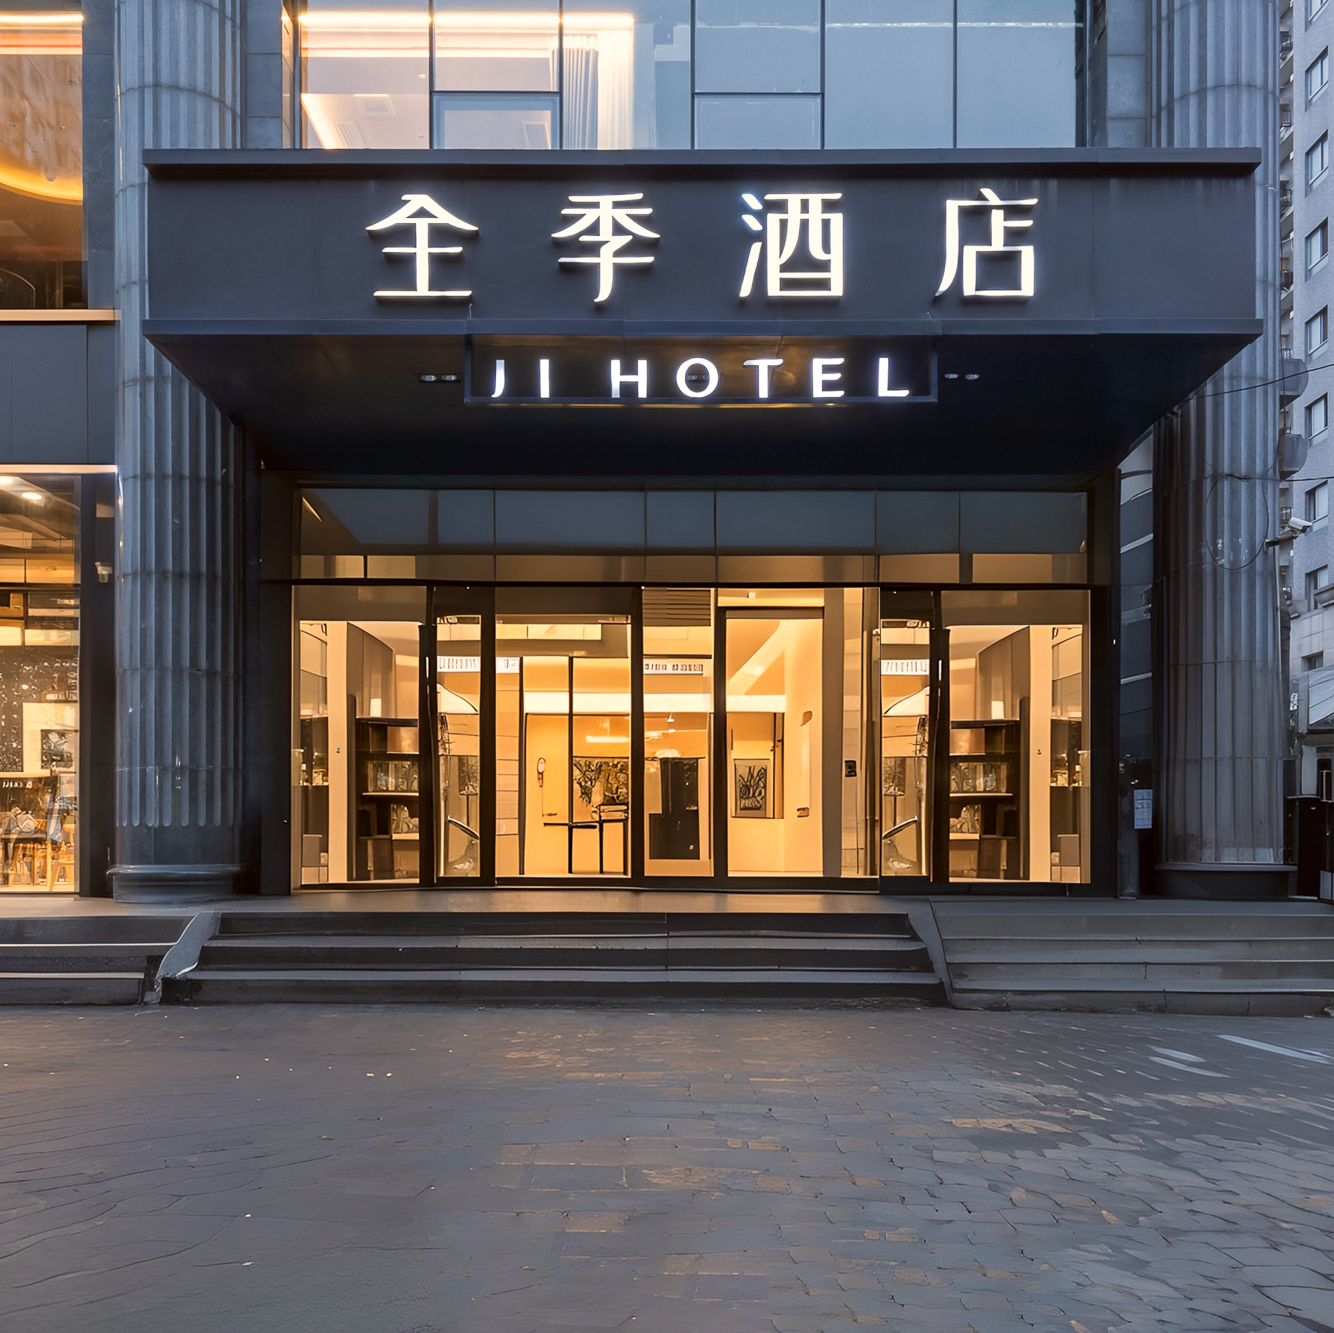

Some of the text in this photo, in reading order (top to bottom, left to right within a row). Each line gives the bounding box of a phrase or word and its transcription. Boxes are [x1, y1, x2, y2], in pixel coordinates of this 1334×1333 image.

[365, 187, 1039, 303] 全季酒店
[491, 357, 910, 399] JI HOTEL
